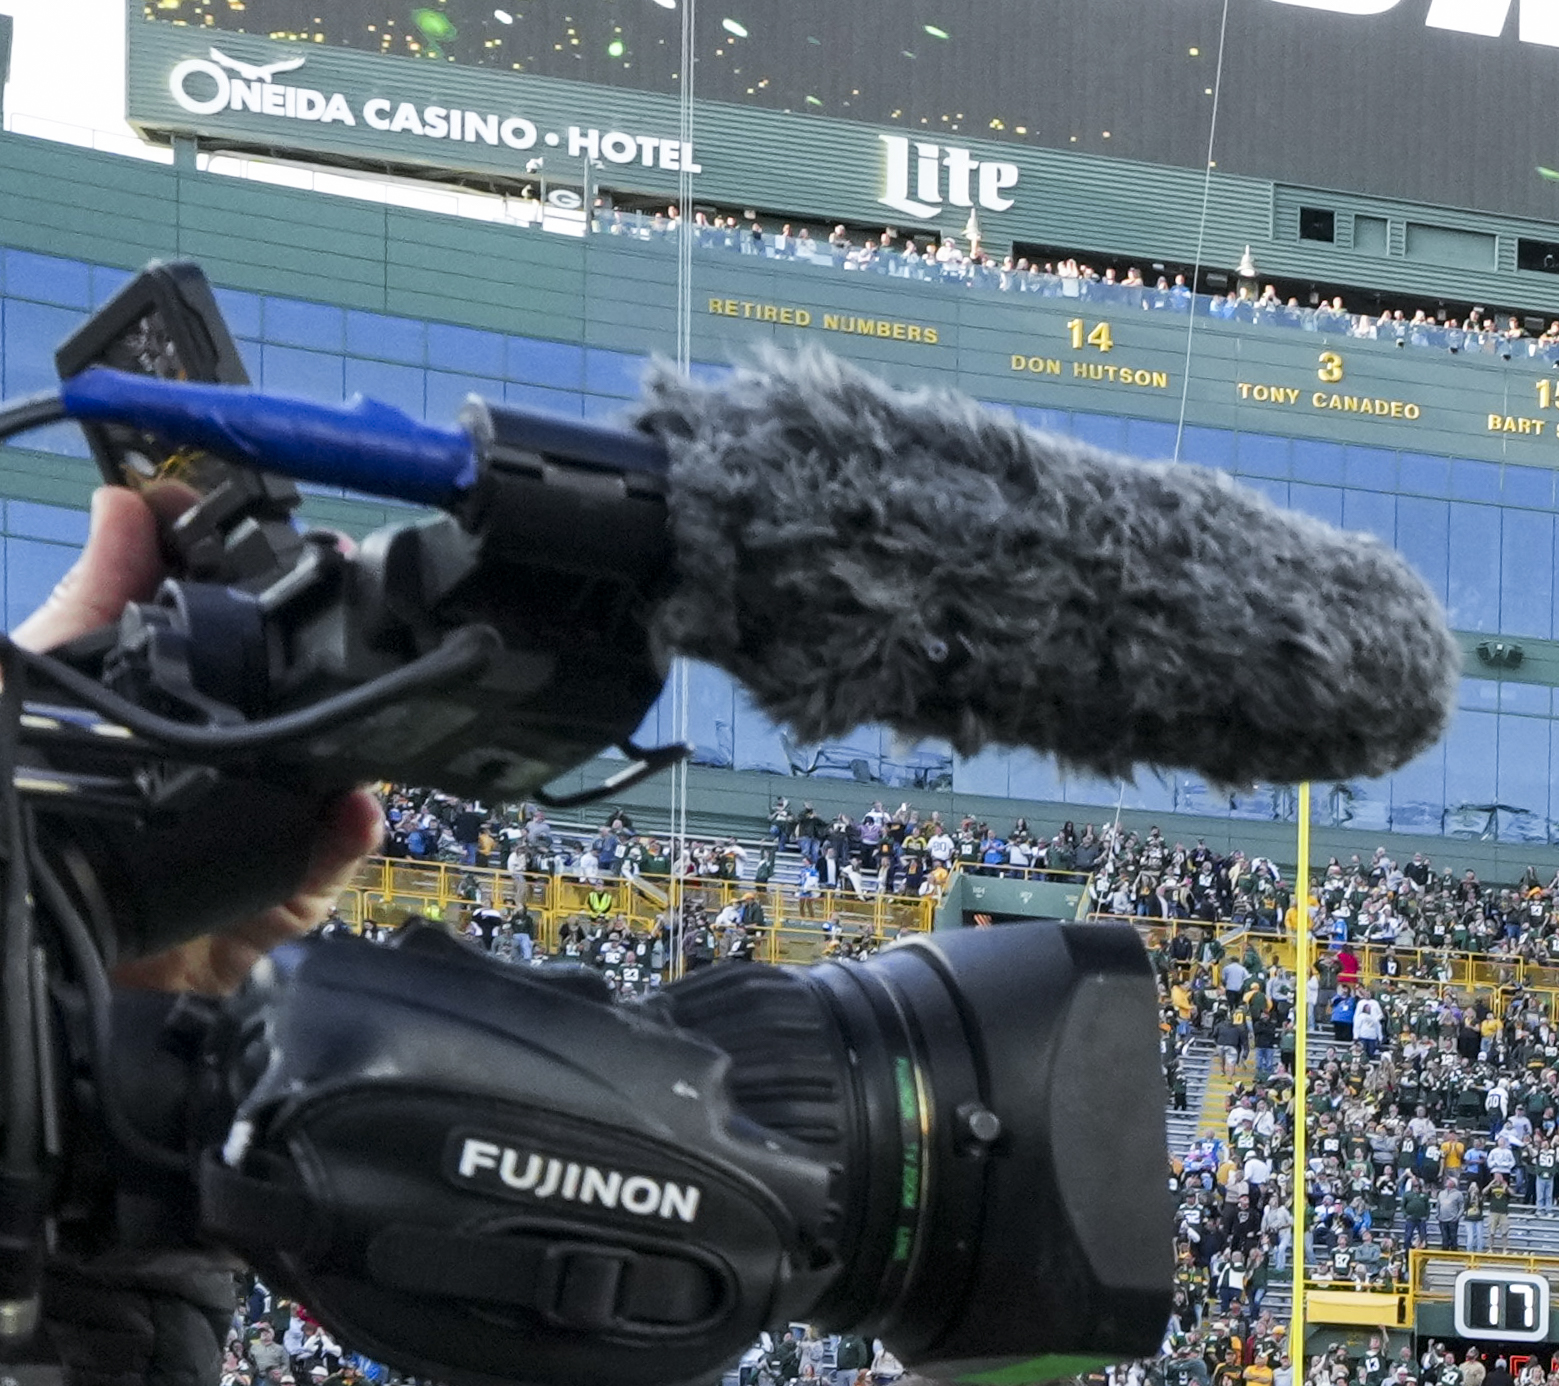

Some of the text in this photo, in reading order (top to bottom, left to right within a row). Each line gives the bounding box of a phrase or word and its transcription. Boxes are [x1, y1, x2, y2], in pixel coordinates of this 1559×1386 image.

[169, 59, 701, 173] ONEIDA CASINO HOTEL
[879, 134, 1018, 218] Lite
[708, 298, 938, 344] RETIRED NUMBERS
[1067, 319, 1113, 352] 14
[1011, 354, 1167, 388] DON HUTSON
[1317, 351, 1344, 382] 3
[1238, 382, 1420, 420] TONY CANADEO
[1487, 413, 1545, 436] BART
[458, 1138, 699, 1223] FUJINON
[1490, 1285, 1533, 1327] 17
